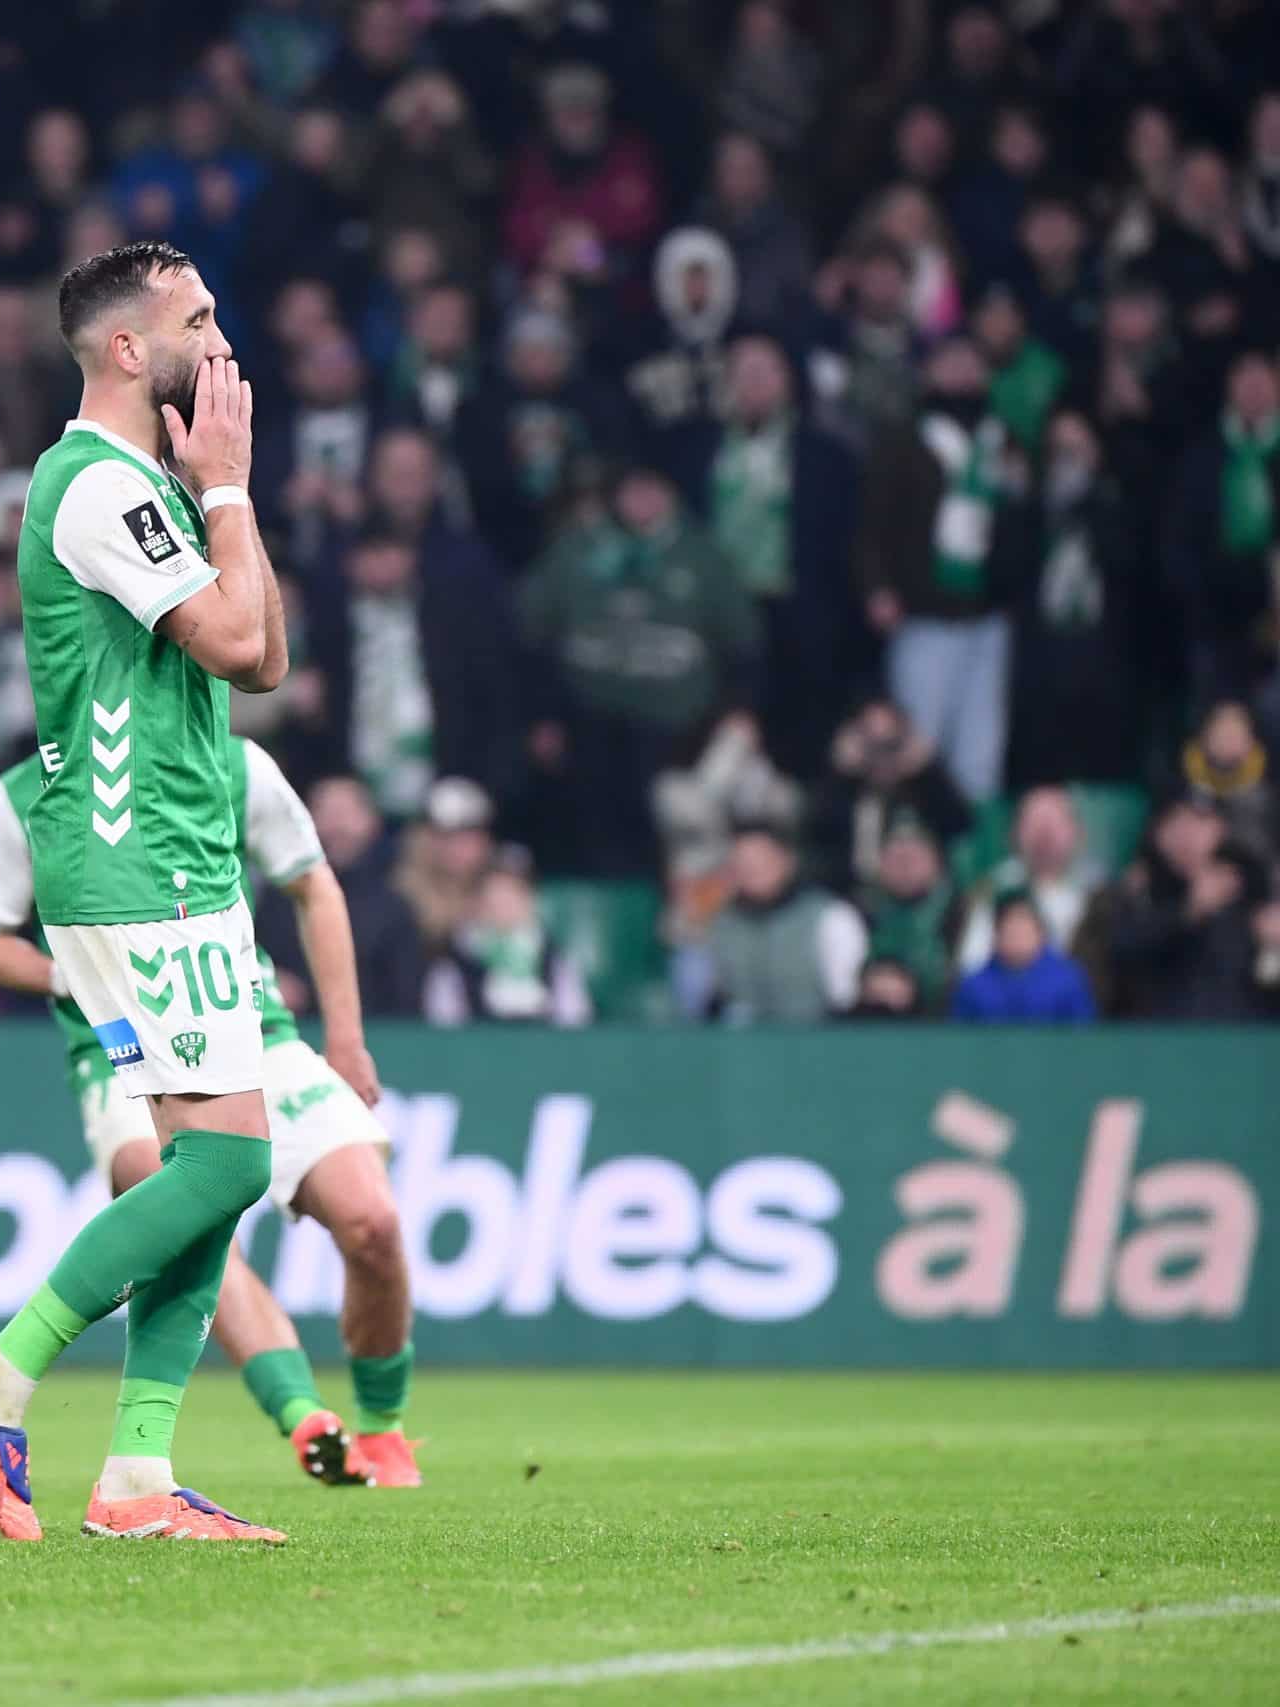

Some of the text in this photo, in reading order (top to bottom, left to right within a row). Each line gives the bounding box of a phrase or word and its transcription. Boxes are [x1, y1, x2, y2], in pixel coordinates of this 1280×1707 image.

[140, 509, 156, 538] 2
[171, 941, 239, 1016] 10
[173, 1032, 204, 1048] ASSE
[875, 1088, 1026, 1320] à
[1056, 1097, 1260, 1320] la
